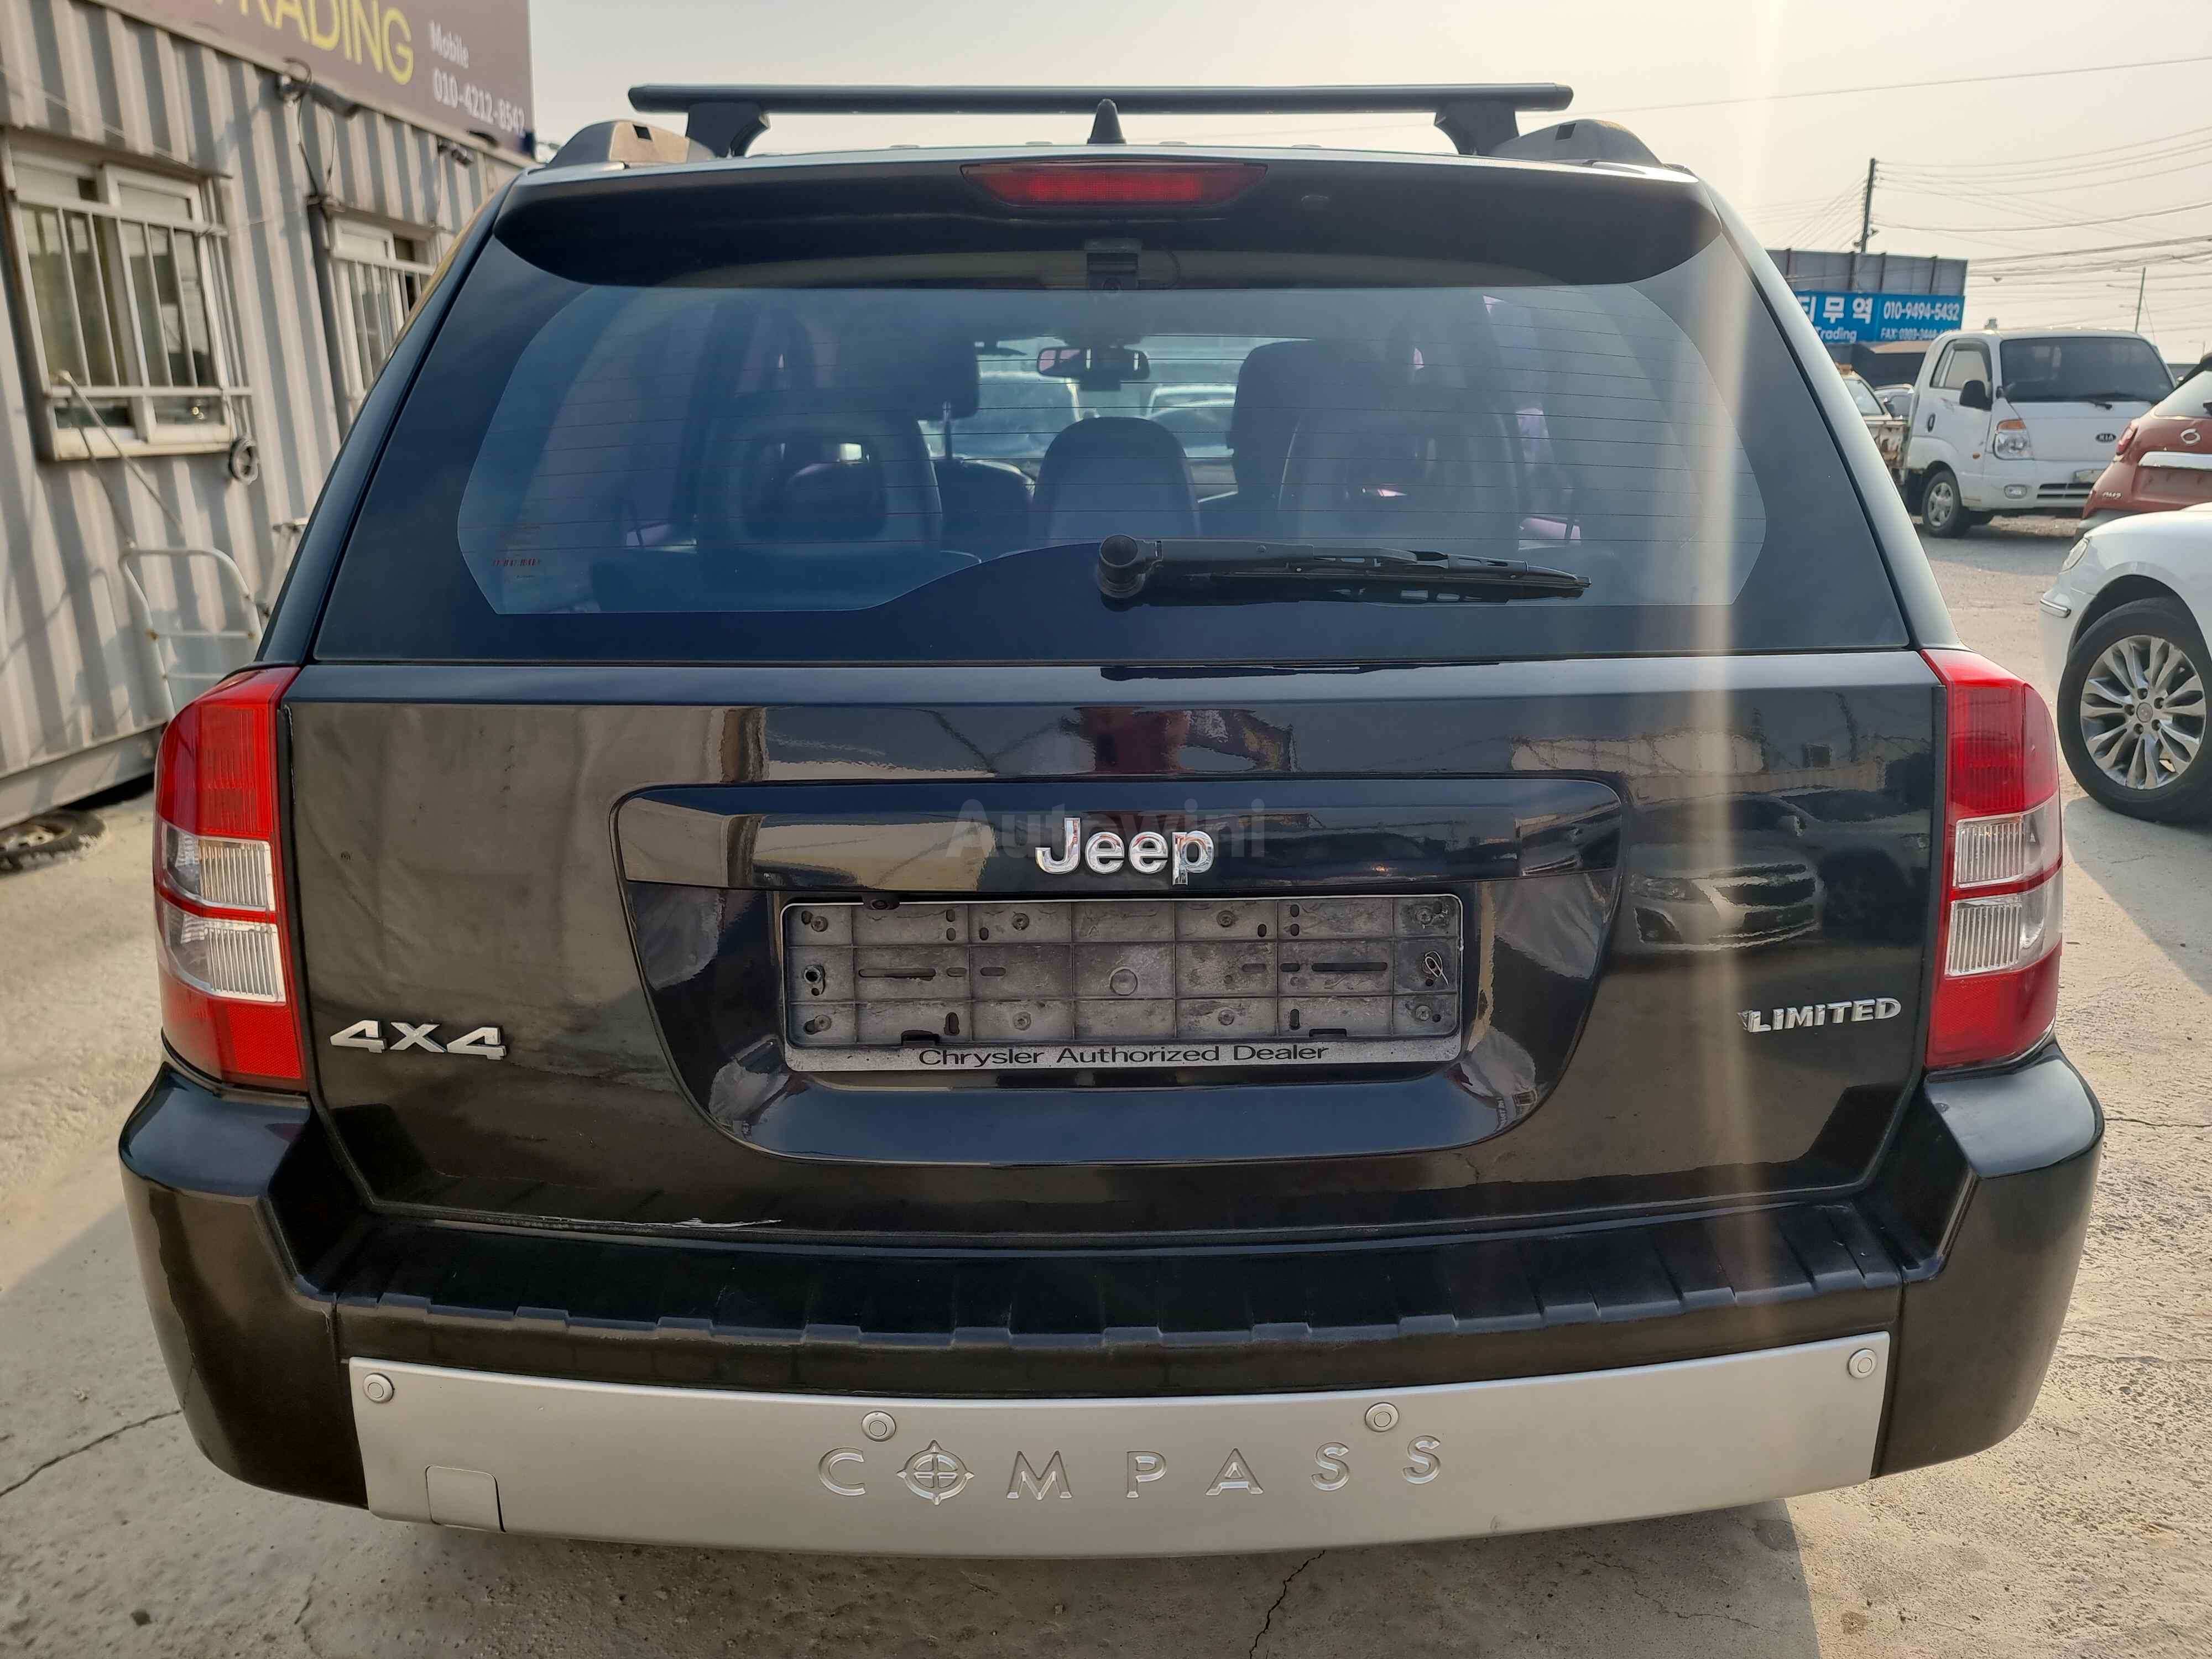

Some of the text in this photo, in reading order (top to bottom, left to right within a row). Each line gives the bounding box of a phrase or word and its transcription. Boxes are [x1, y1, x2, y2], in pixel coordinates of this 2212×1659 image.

[430, 19, 469, 69] Mobile
[1884, 301, 1959, 321] 010-9494-5432
[2098, 434, 2115, 442] KIA
[1035, 816, 1215, 886] Jeep
[1746, 997, 1902, 1032] LIMITED
[919, 1044, 1329, 1067] Chrysler Authorized Dealer
